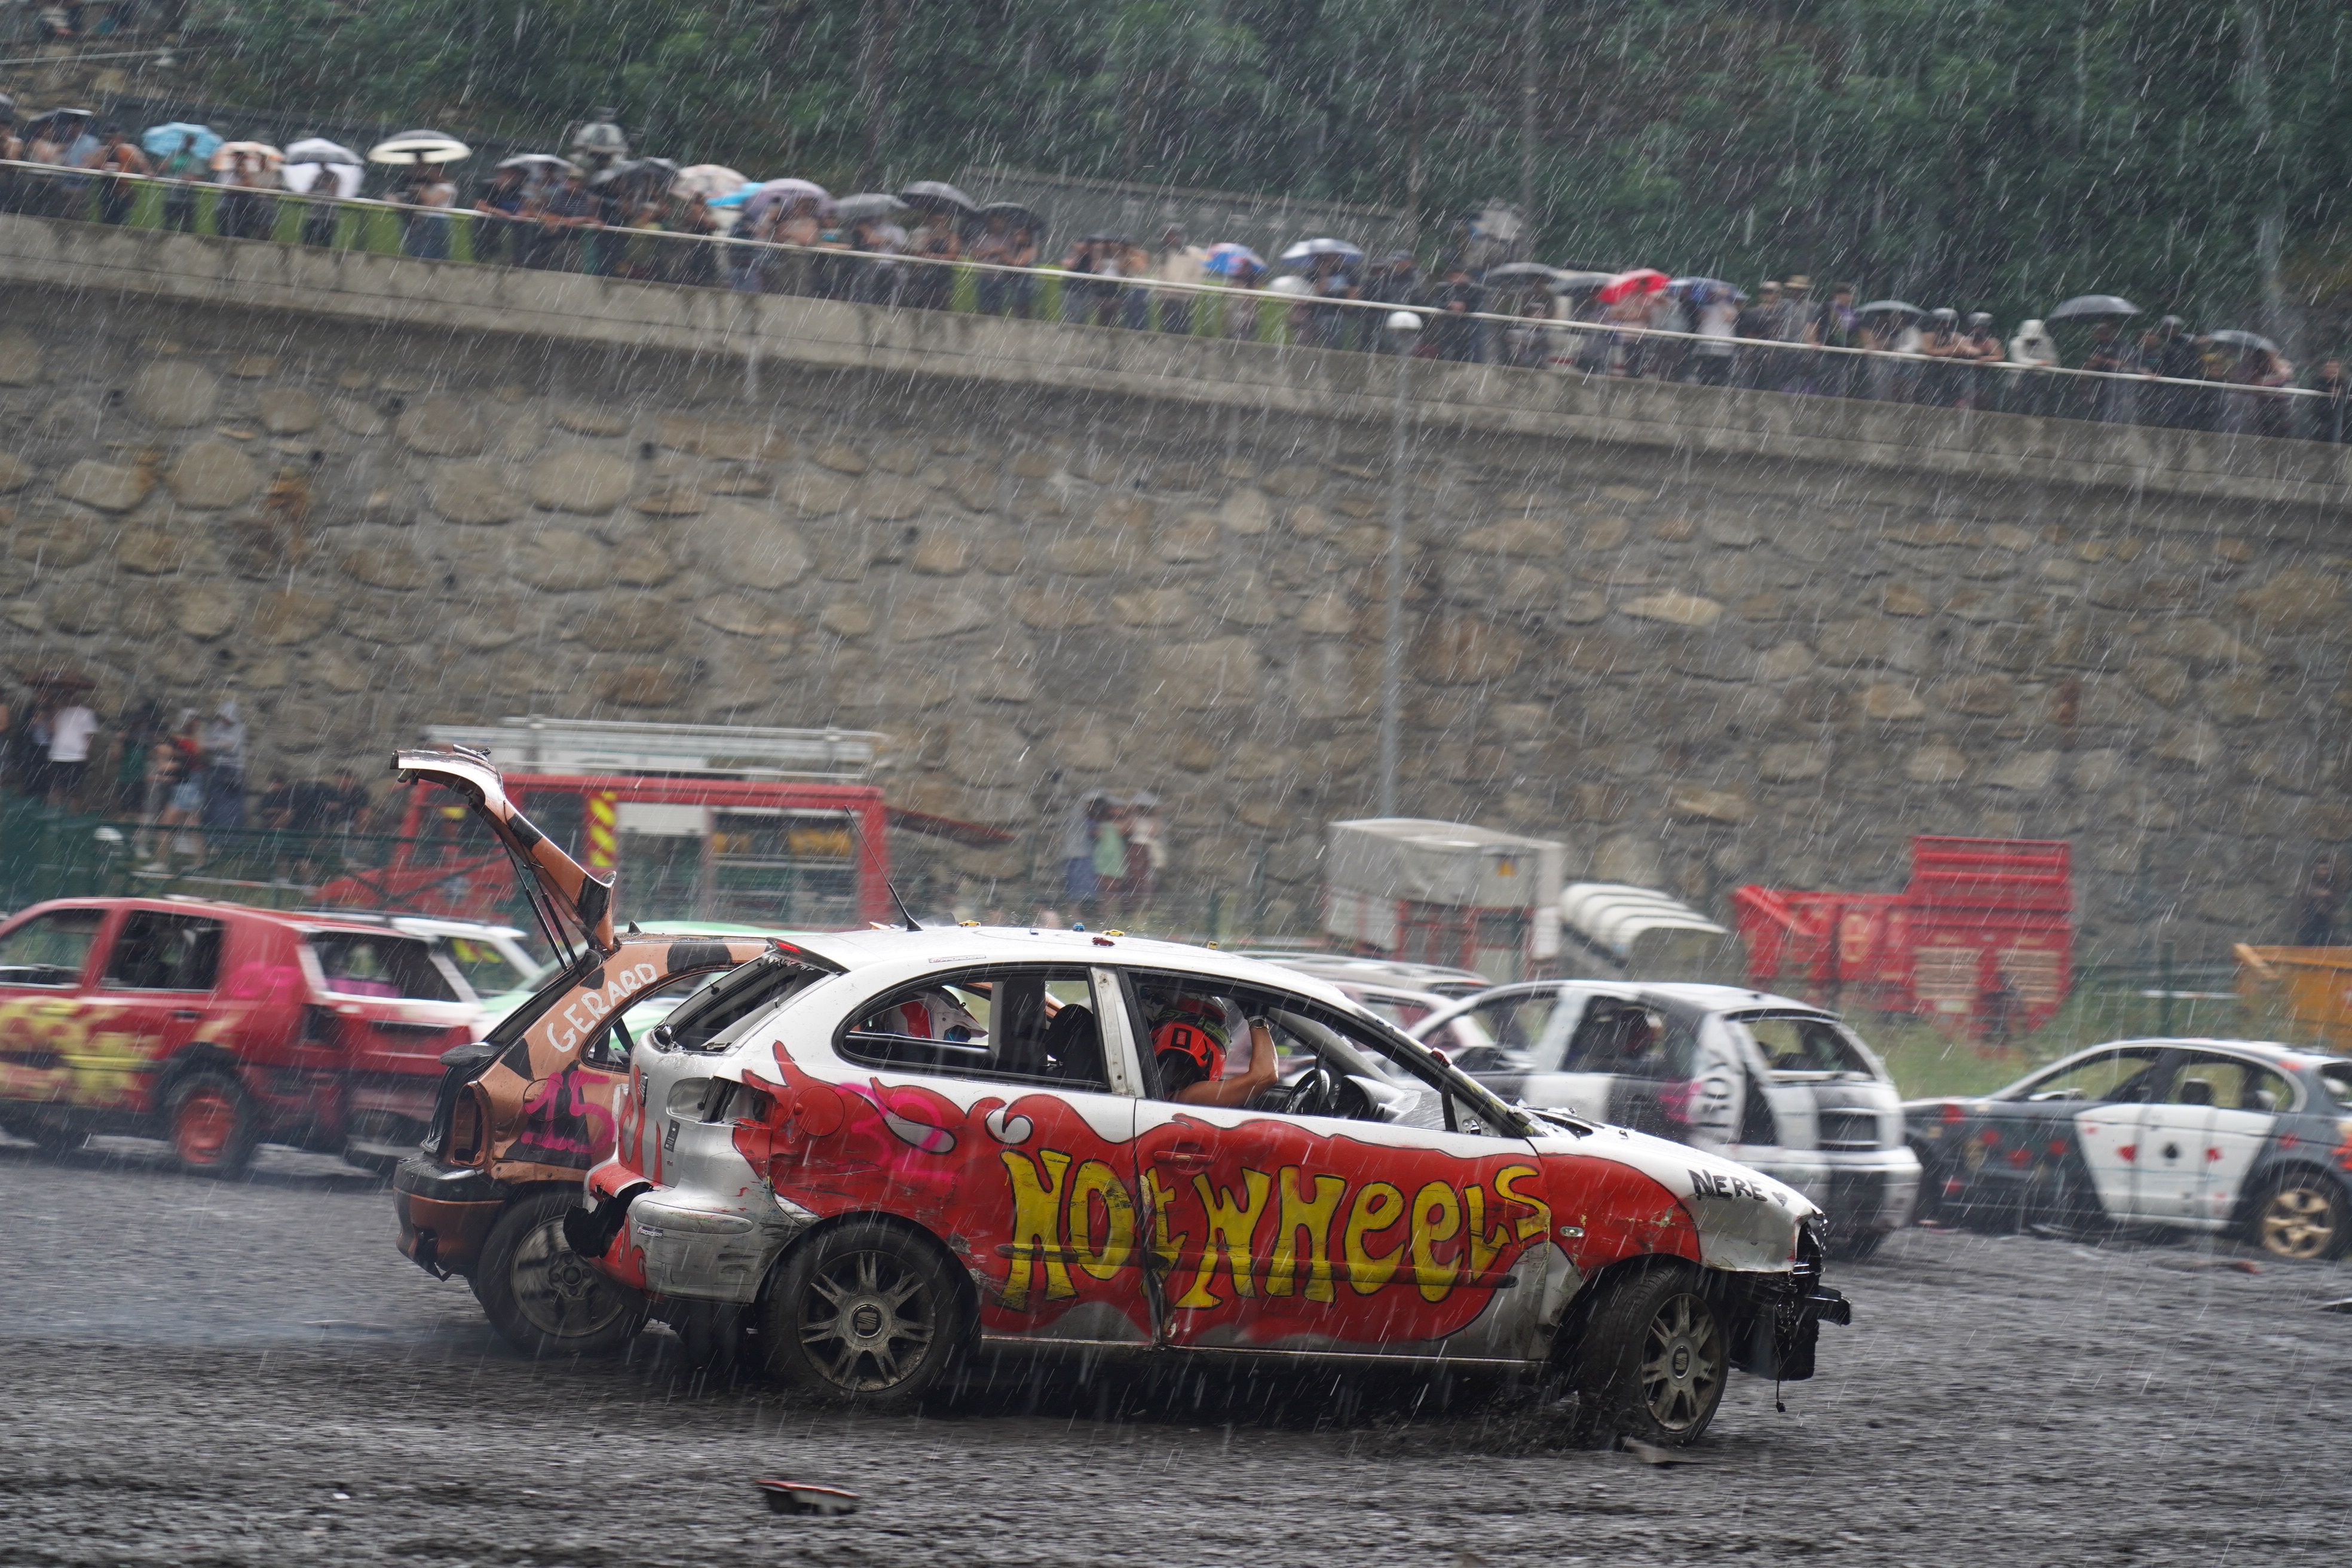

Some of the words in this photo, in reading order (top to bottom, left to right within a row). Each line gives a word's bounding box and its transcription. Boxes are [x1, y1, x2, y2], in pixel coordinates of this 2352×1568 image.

[546, 963, 658, 1053] GERARD
[520, 1070, 615, 1154] 15
[835, 1082, 956, 1183] 32
[1687, 1168, 1769, 1202] NERE
